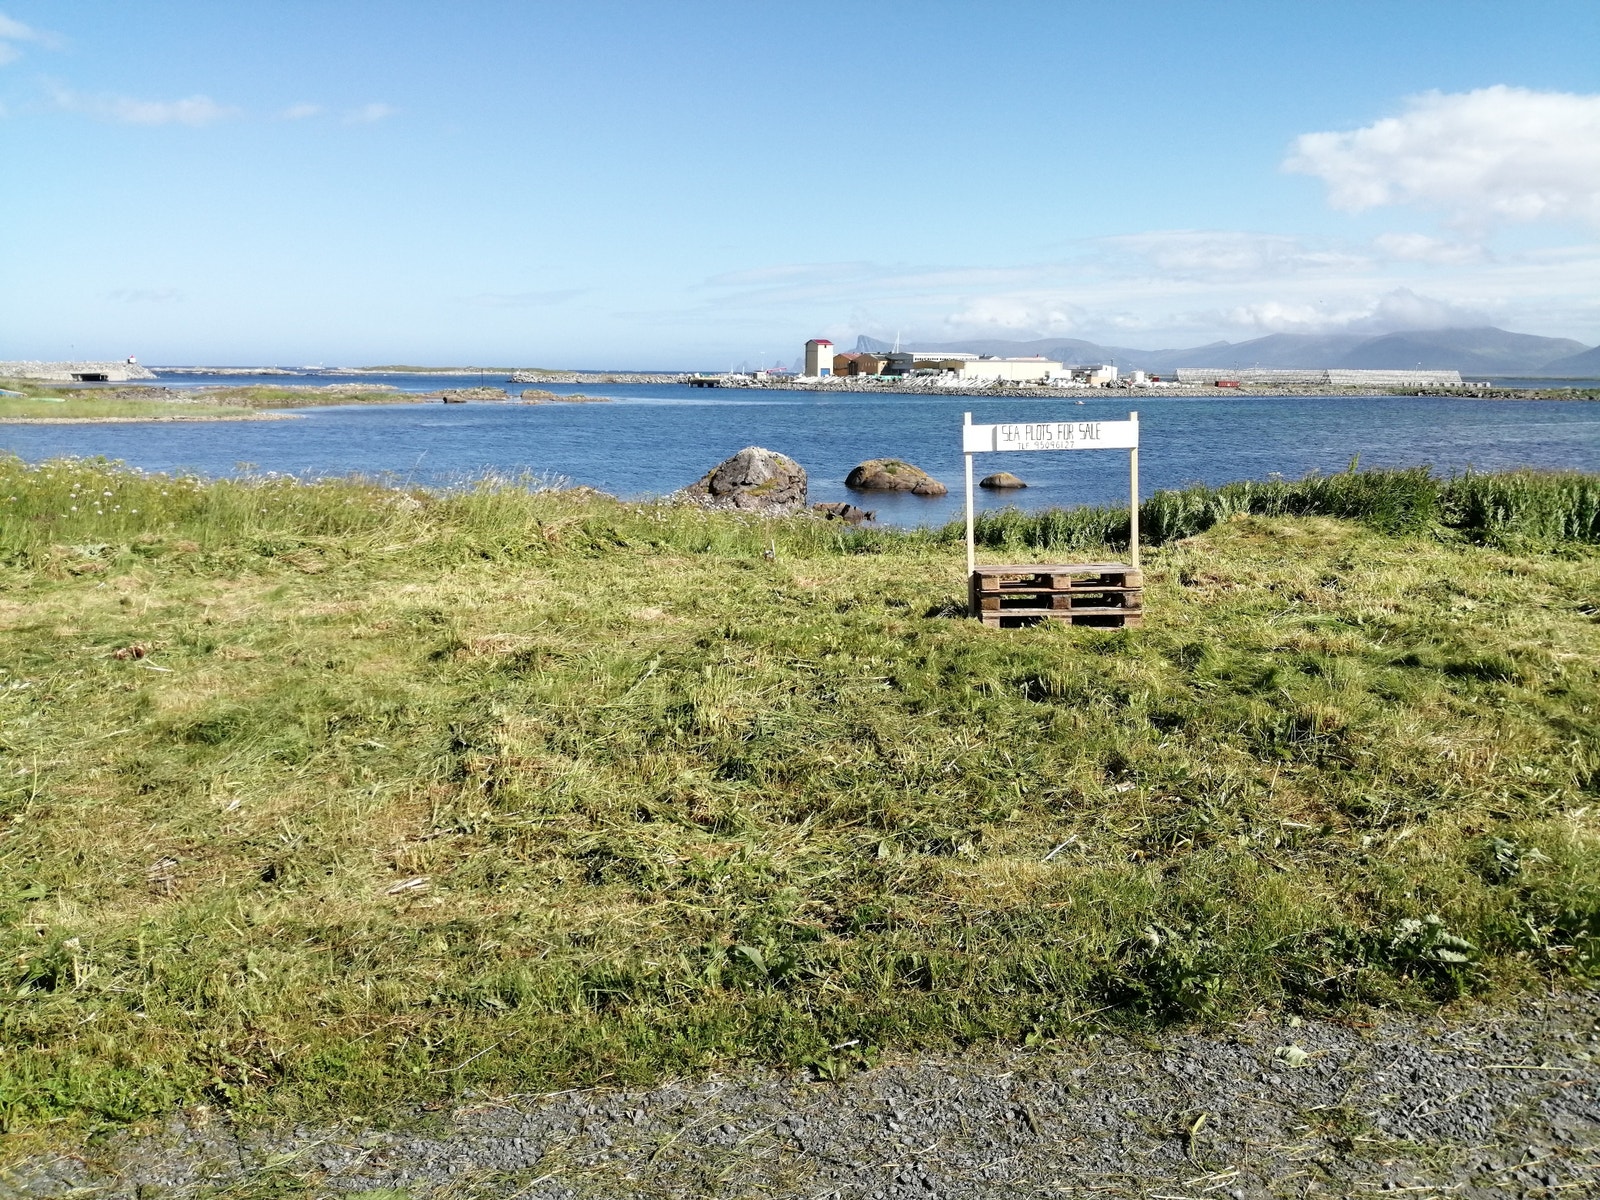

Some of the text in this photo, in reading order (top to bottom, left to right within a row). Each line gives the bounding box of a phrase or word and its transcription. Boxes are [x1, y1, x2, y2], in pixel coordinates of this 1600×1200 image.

[1001, 422, 1101, 441] SEA PLOTS FOR SALE
